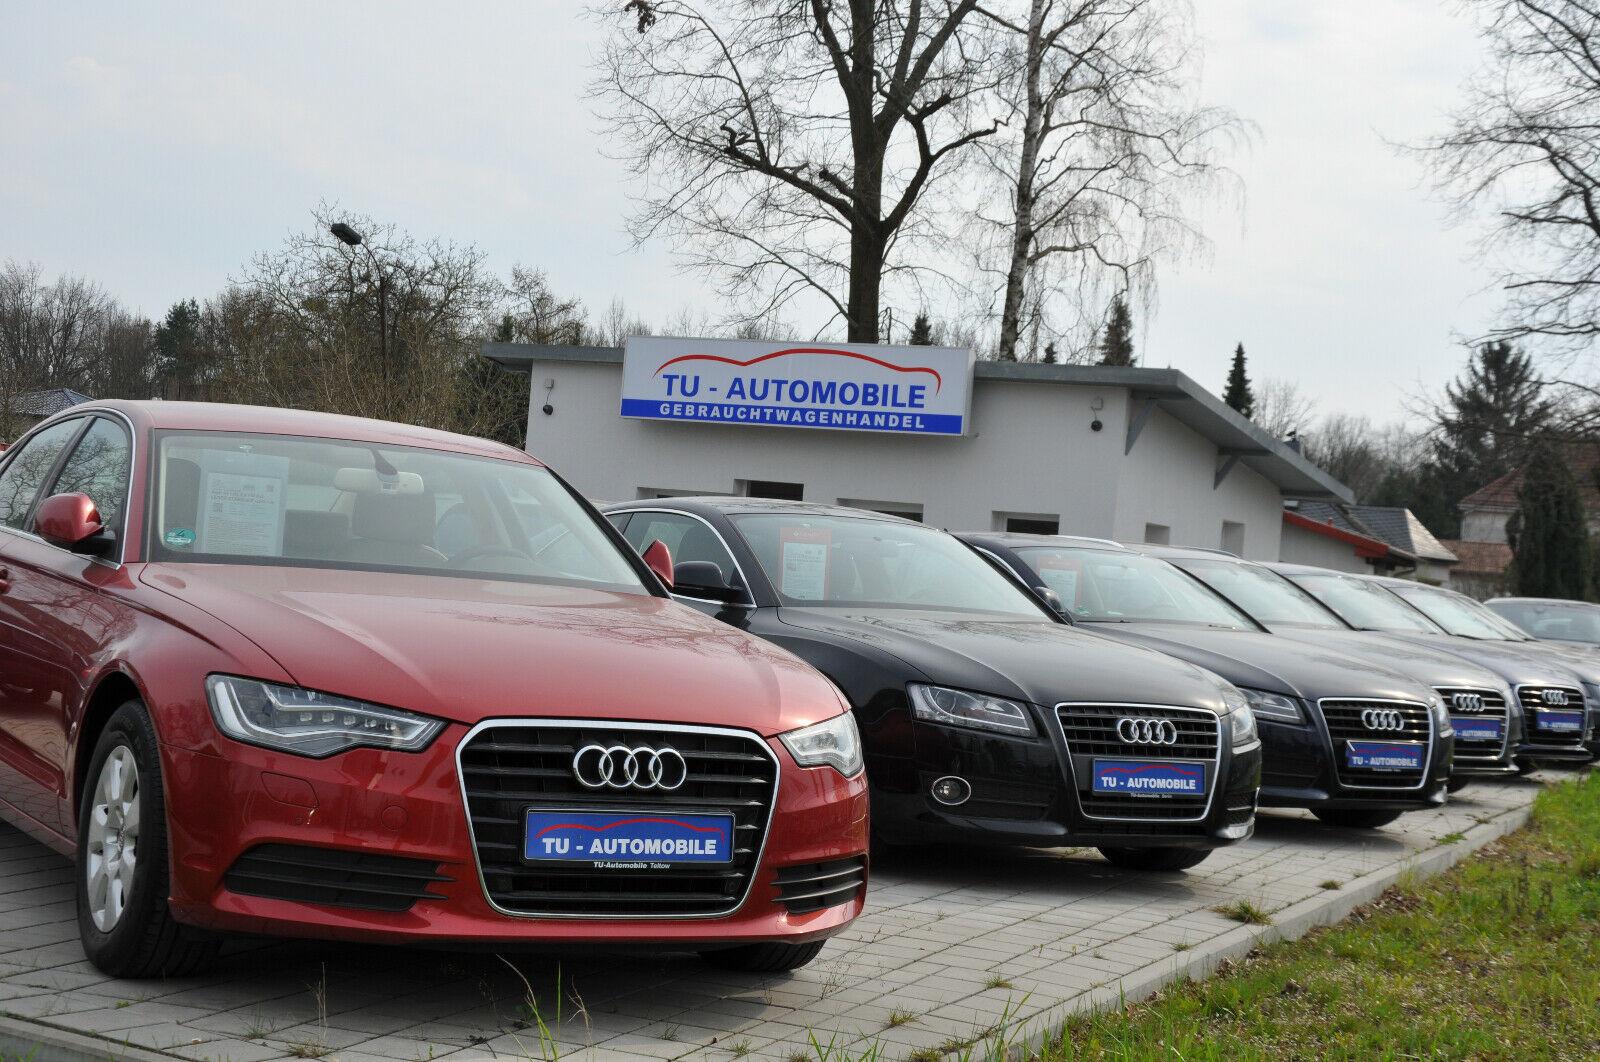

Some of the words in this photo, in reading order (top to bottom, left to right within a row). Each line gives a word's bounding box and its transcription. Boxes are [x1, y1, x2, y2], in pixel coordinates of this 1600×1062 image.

[662, 374, 700, 397] TU
[726, 377, 926, 409] AUTOMOBILE
[660, 403, 925, 429] GEBRAUCHTWAGENHANDEL
[1352, 756, 1364, 765] TU
[1370, 757, 1418, 767] AUTOMOBILE
[1101, 776, 1117, 788] TU
[1126, 778, 1196, 790] AUTOMOBILE
[542, 838, 570, 854] TU
[589, 838, 717, 855] AUTOMOBILE
